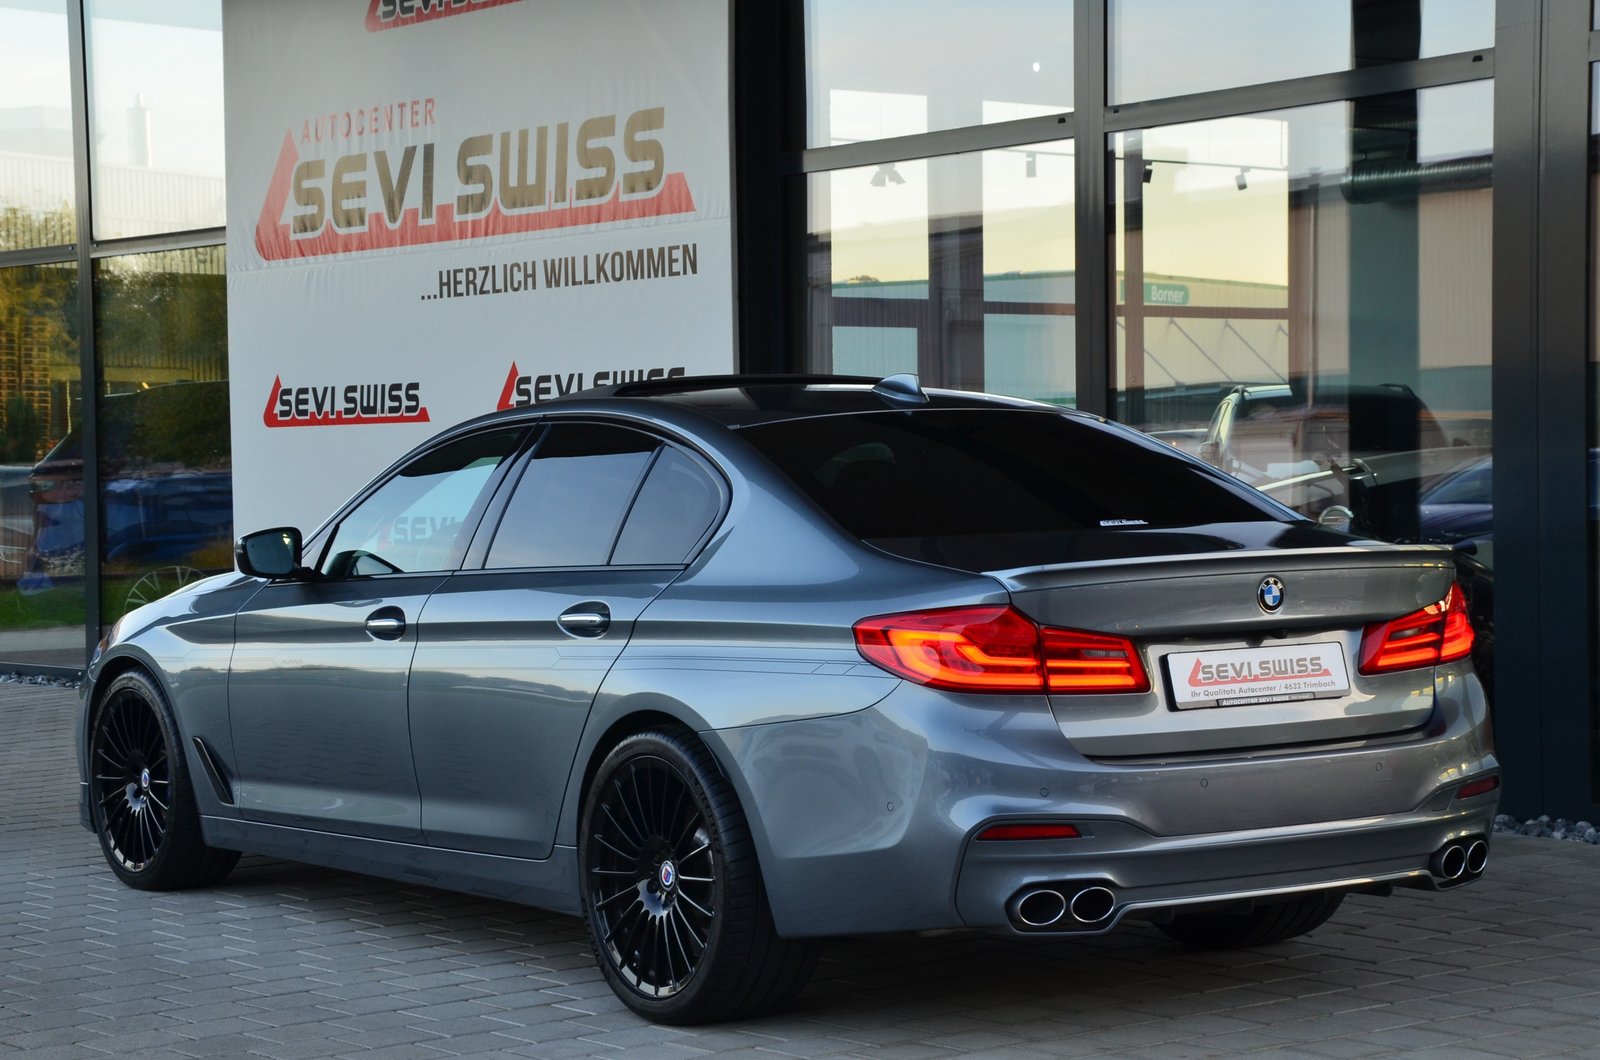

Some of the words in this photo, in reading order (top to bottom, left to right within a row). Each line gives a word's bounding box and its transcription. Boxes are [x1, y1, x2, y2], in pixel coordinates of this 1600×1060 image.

[301, 97, 436, 145] AUTOCENTER
[293, 142, 435, 234] SEVI
[456, 106, 665, 216] SWISS
[421, 259, 537, 300] ...HERZLICH
[542, 243, 698, 289] WILLKOMMEN
[1151, 285, 1185, 303] Borner
[279, 386, 336, 418] SEVI
[343, 382, 420, 416] SWISS
[1201, 661, 1253, 681] SEVI
[1258, 656, 1323, 677] SWISS
[1190, 690, 1202, 698] Ihr
[1238, 685, 1277, 695] Autocenter
[1283, 681, 1302, 691] 4632
[1303, 679, 1336, 689] Trimbach
